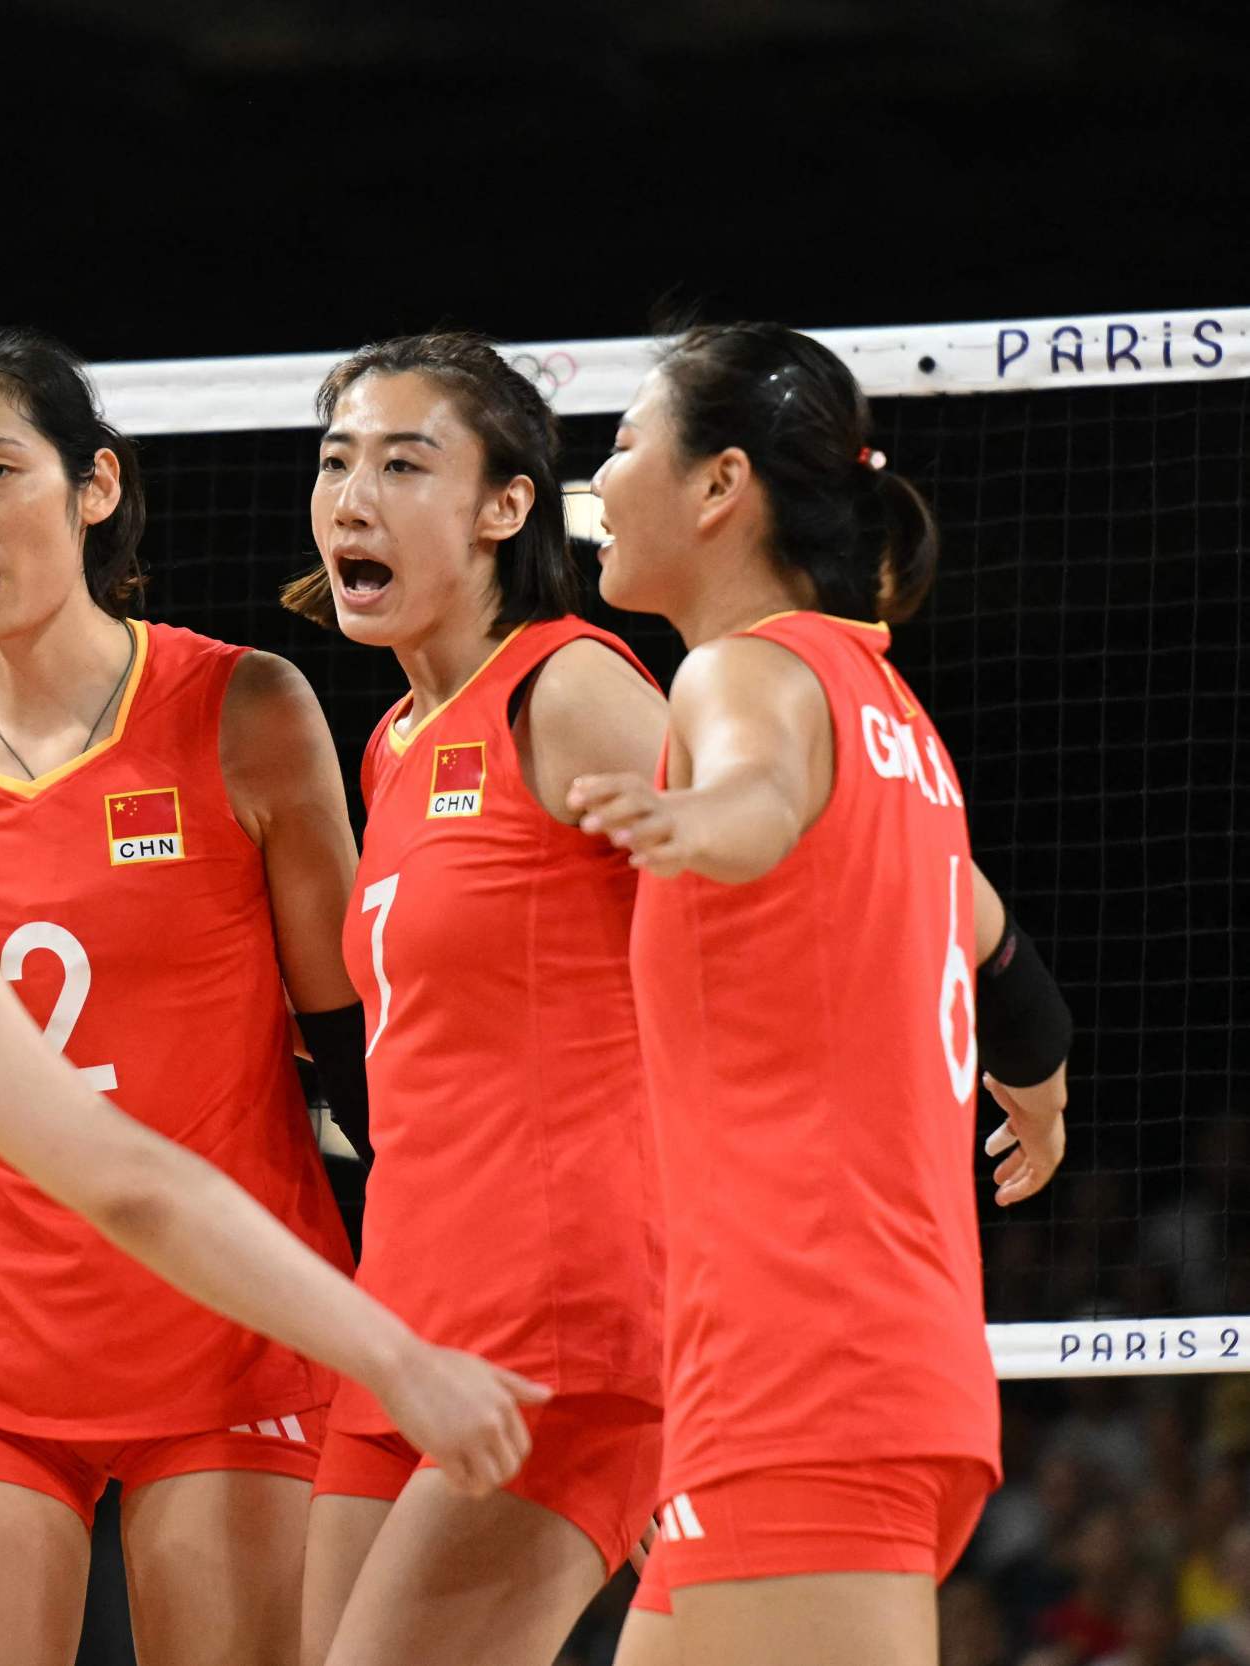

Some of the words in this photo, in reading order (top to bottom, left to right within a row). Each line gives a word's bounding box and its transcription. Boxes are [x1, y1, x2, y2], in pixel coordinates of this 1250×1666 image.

[119, 838, 174, 858] CHN
[434, 795, 475, 813] CHN
[1, 921, 118, 1092] 2
[361, 872, 399, 1058] 7
[939, 855, 978, 1106] 6
